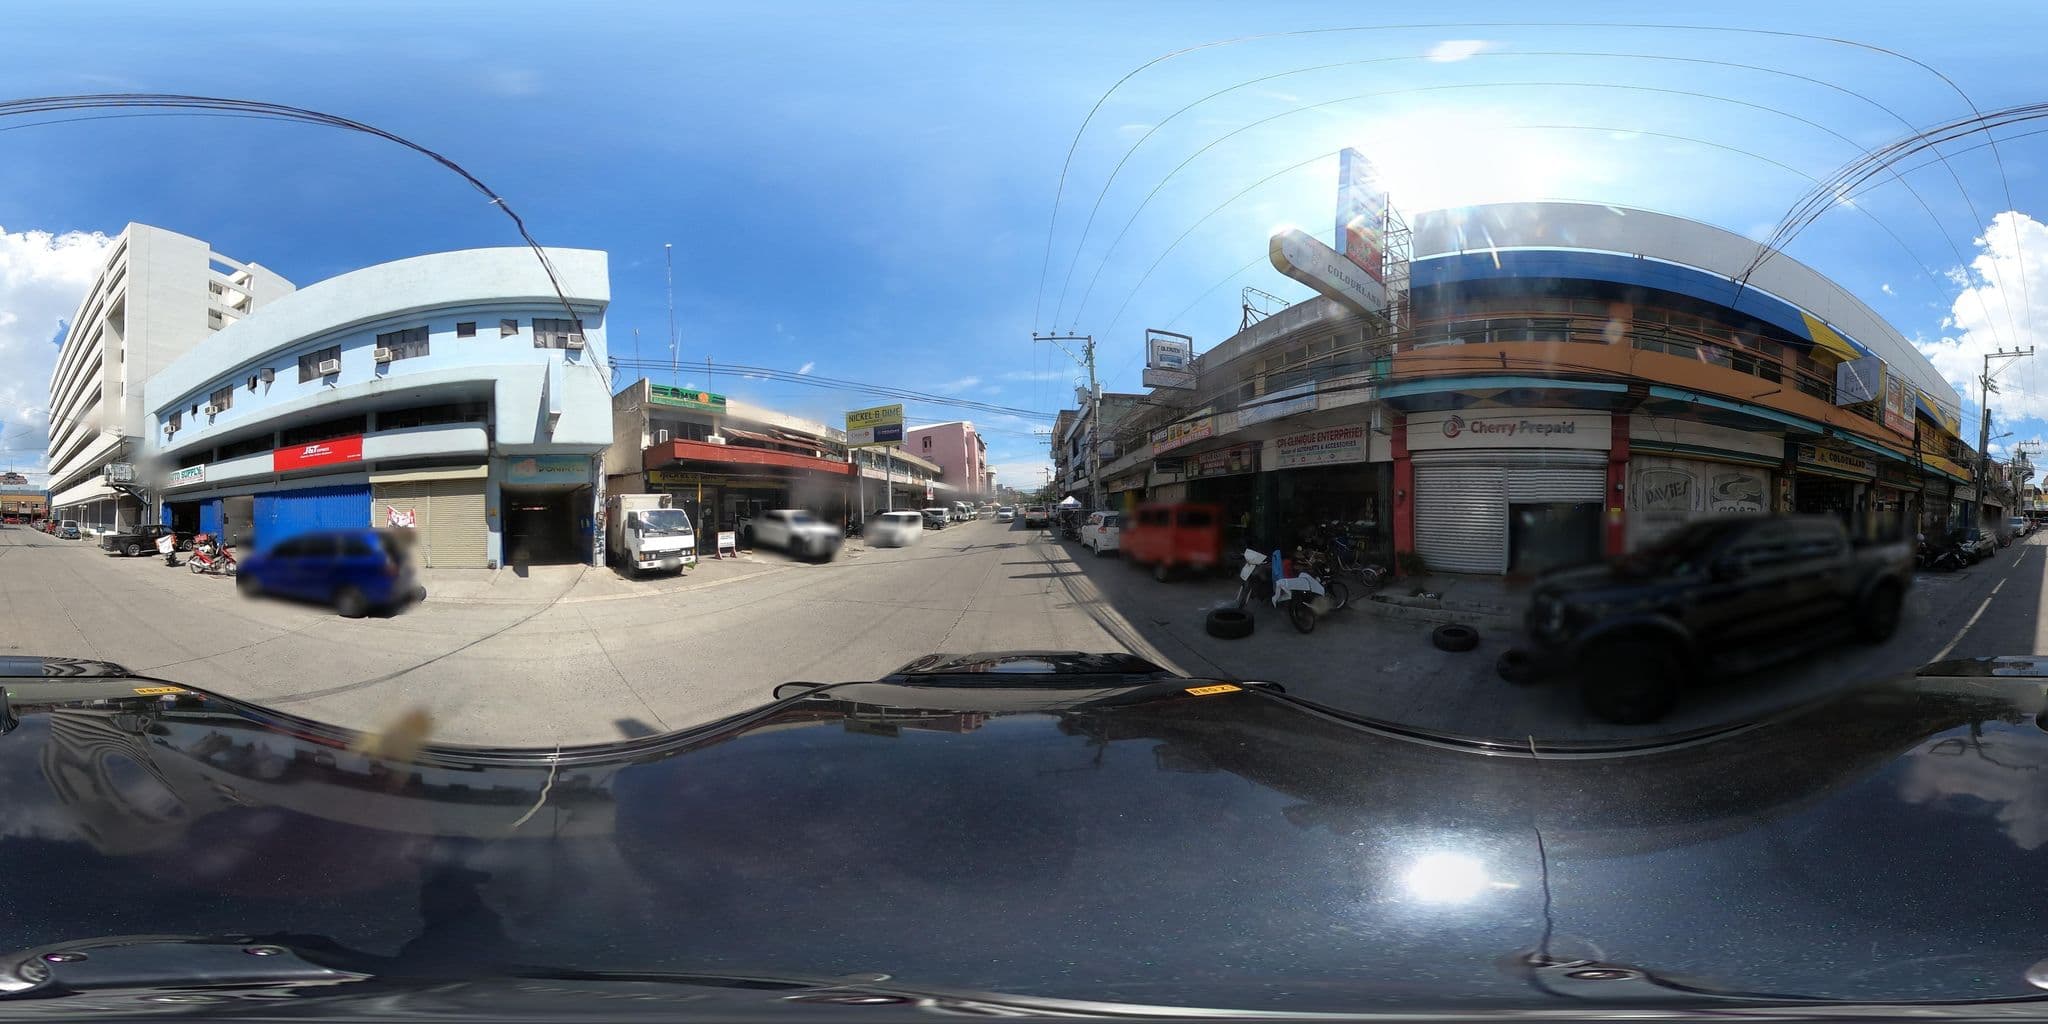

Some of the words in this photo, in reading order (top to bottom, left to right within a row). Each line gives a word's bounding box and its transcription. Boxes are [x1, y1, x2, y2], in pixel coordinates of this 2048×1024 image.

[848, 412, 872, 422] NICKEL
[882, 408, 900, 417] DIME
[1470, 420, 1516, 436] Cherry
[1519, 420, 1575, 436] Prepaid
[1645, 480, 1688, 505] DAVIES
